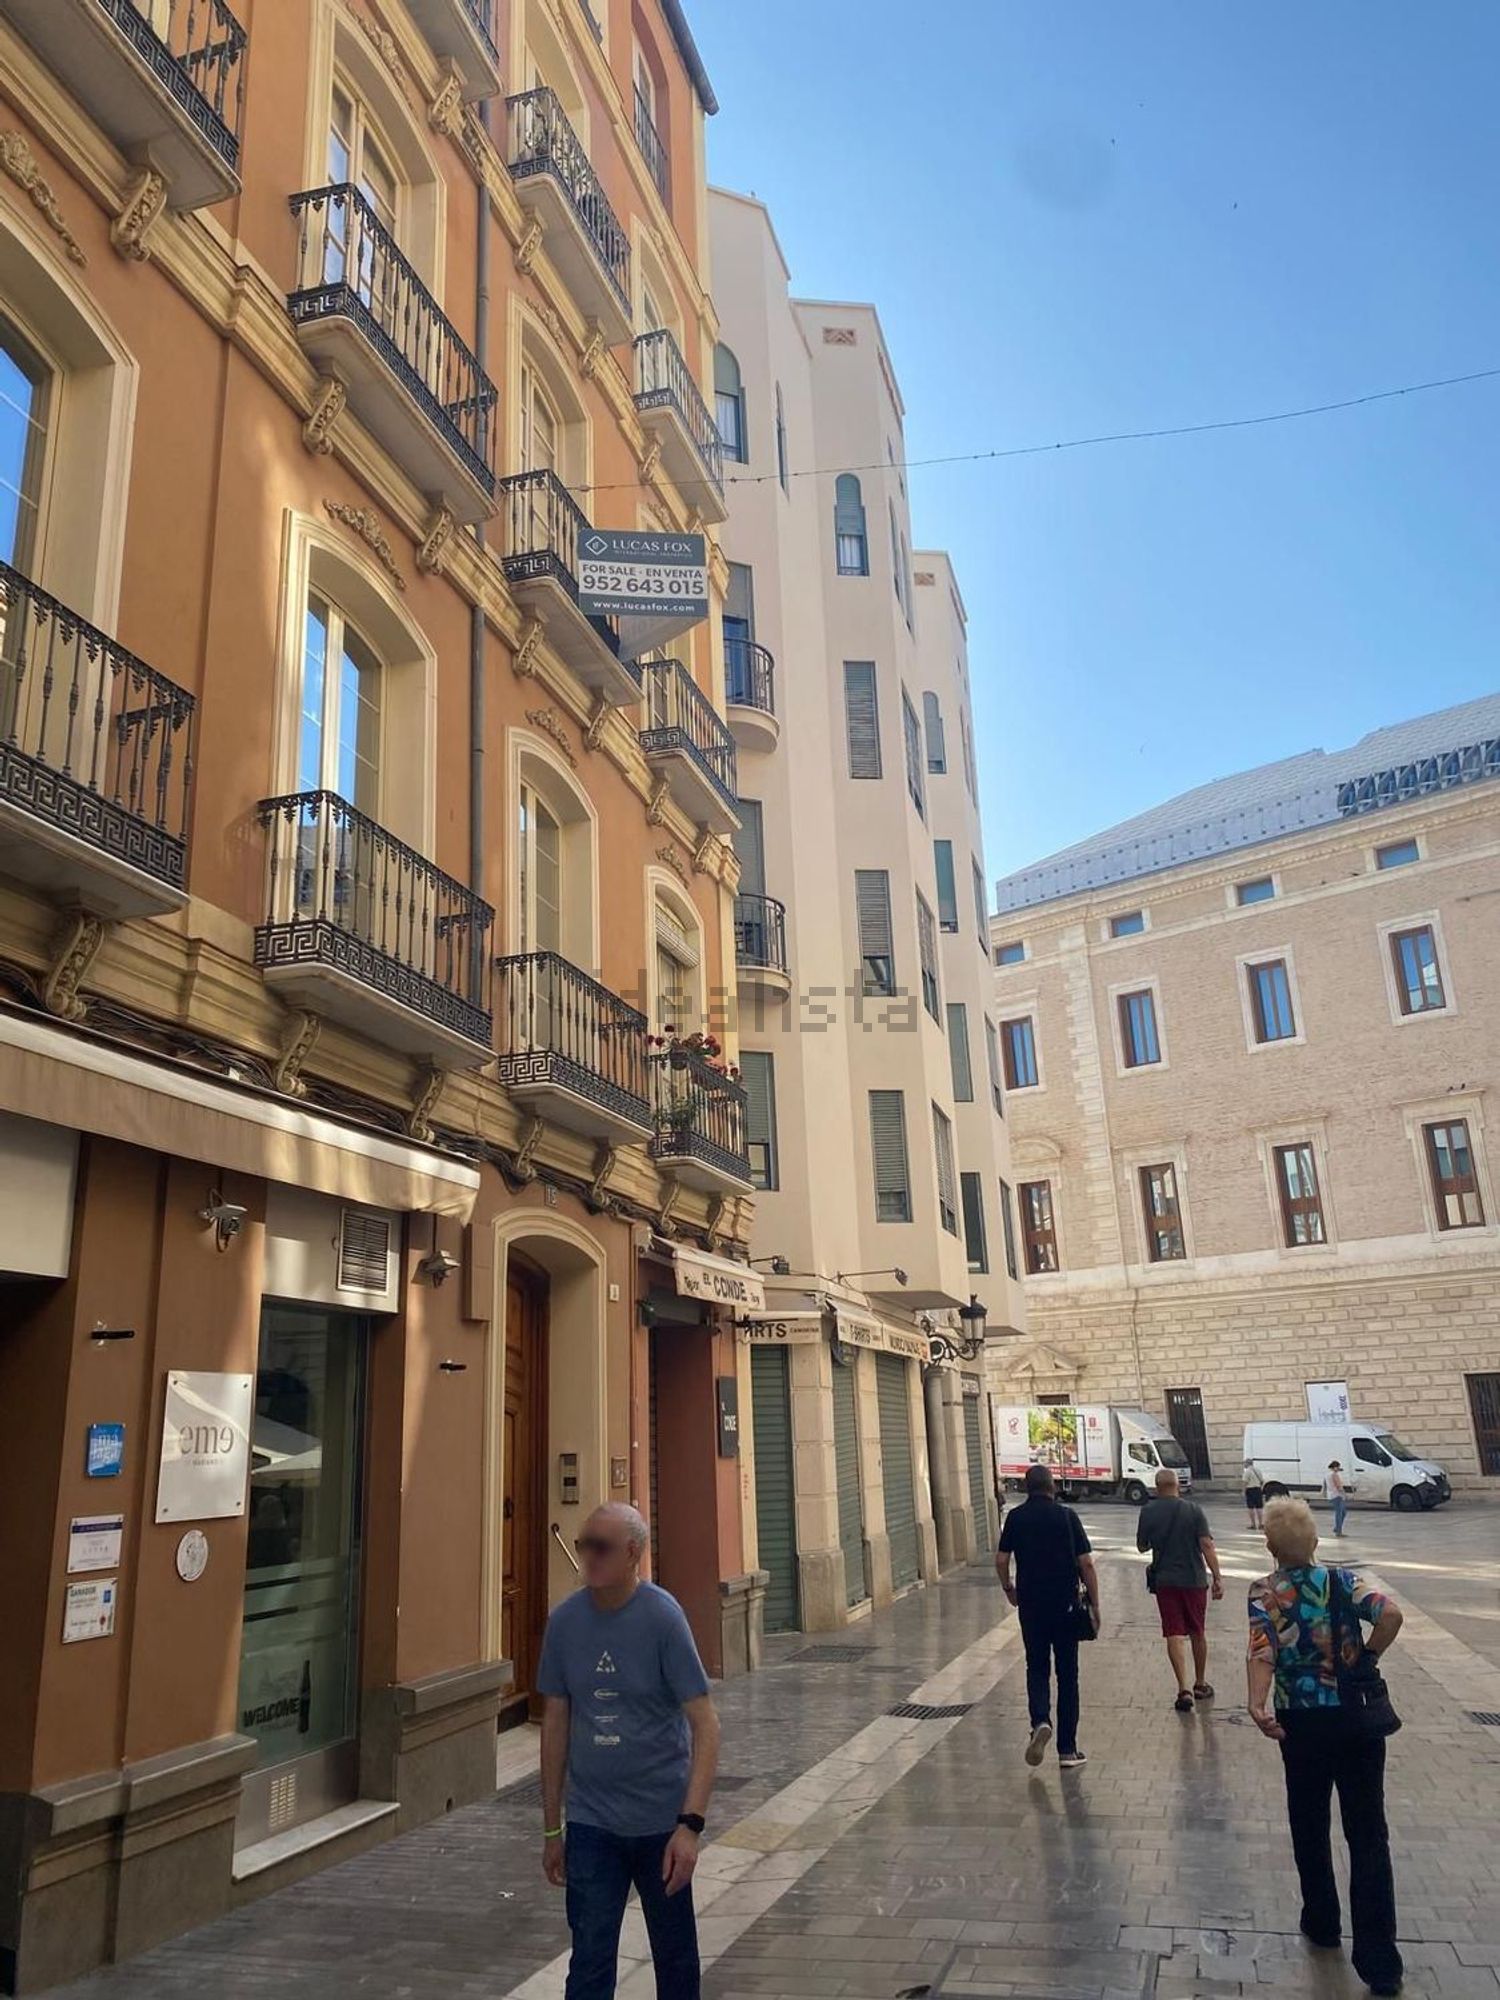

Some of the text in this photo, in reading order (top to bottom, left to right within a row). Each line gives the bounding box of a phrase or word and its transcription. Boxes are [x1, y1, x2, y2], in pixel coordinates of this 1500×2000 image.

[612, 540, 692, 553] LUCAS FOX
[582, 564, 606, 574] FOR
[609, 565, 637, 577] SALE
[646, 569, 662, 577] EN
[664, 570, 703, 579] VENTA
[583, 575, 704, 595] 952 643 015
[593, 601, 695, 612] www.lucasfox.com
[714, 1275, 748, 1302] CONDE
[243, 1697, 301, 1728] WELCOME
